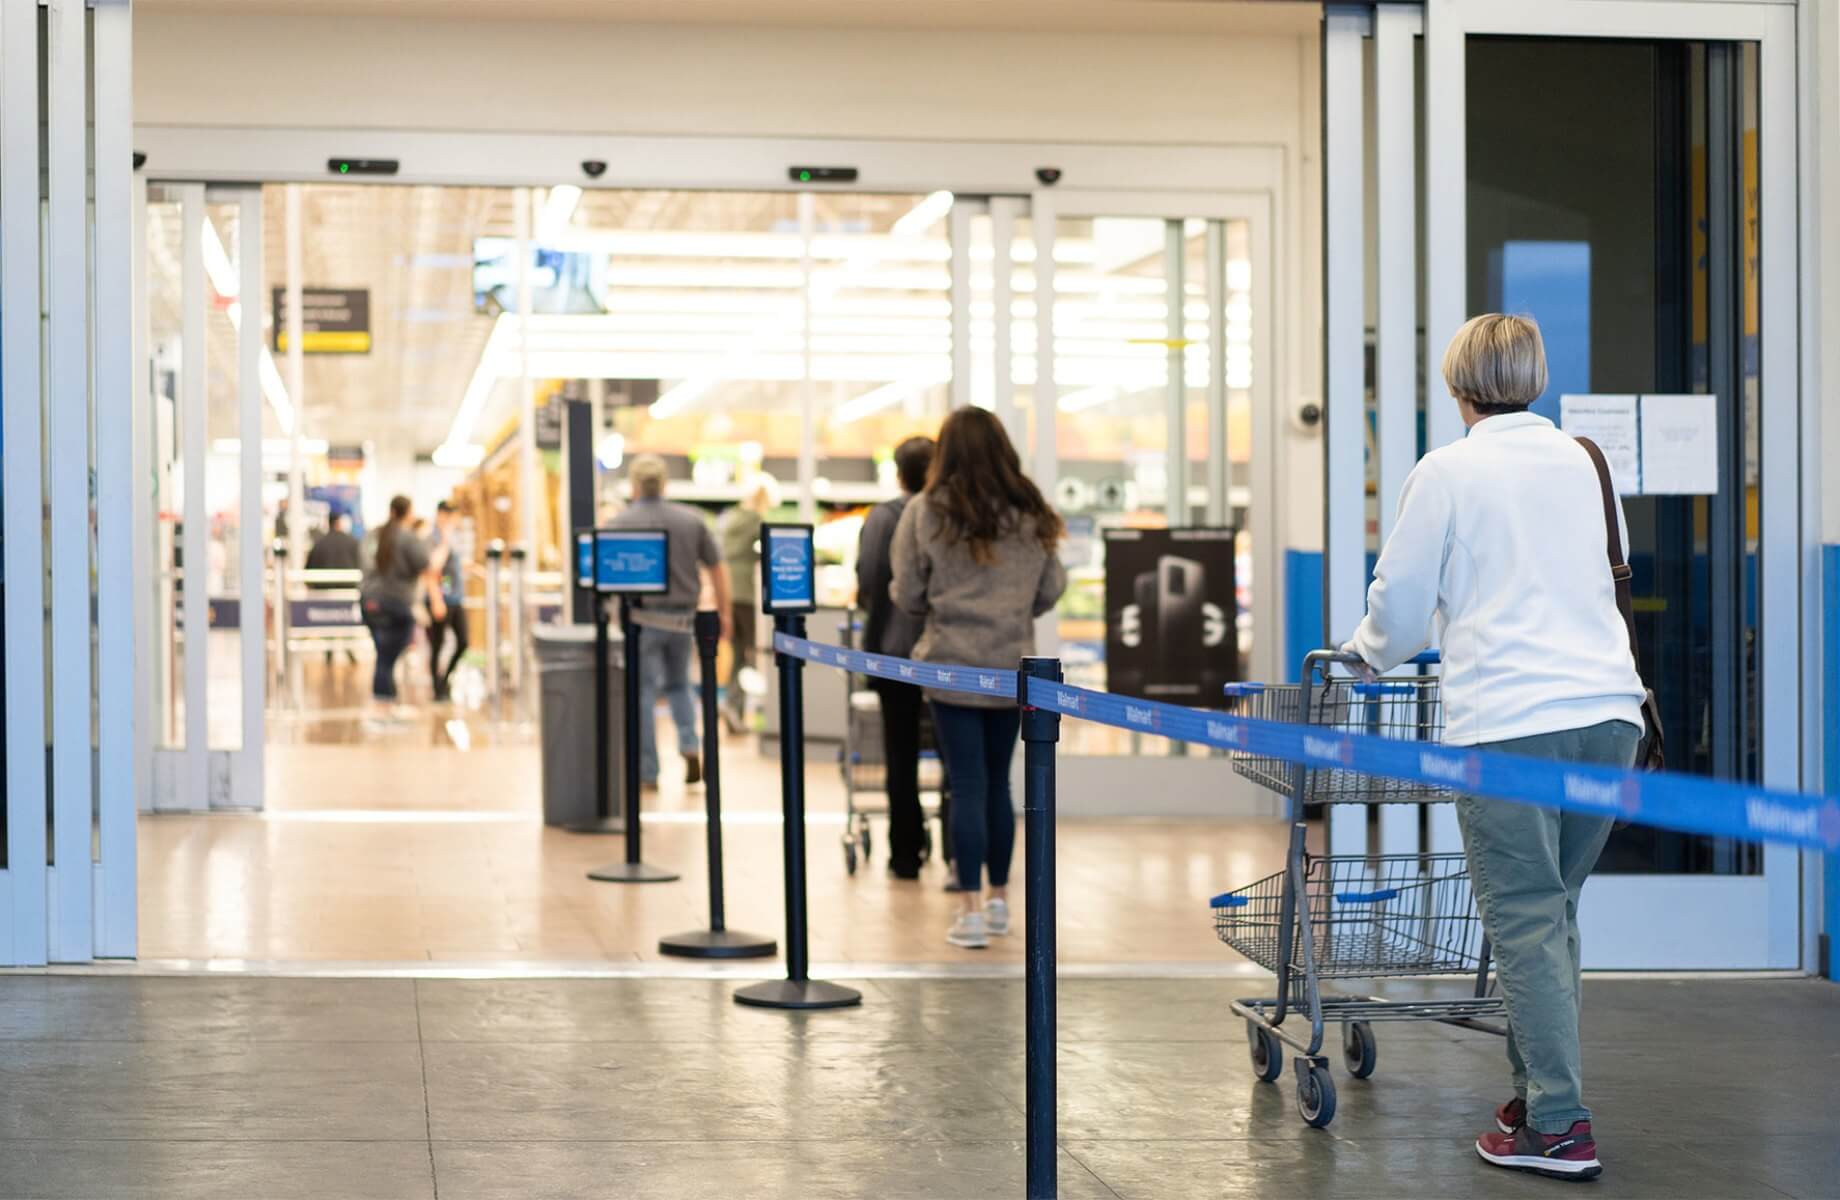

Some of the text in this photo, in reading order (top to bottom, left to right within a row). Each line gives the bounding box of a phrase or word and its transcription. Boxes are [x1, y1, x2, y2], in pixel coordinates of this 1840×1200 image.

[1057, 690, 1818, 837] Walmart Walmart Walmart Walmart Walmart Walmart Walmart
